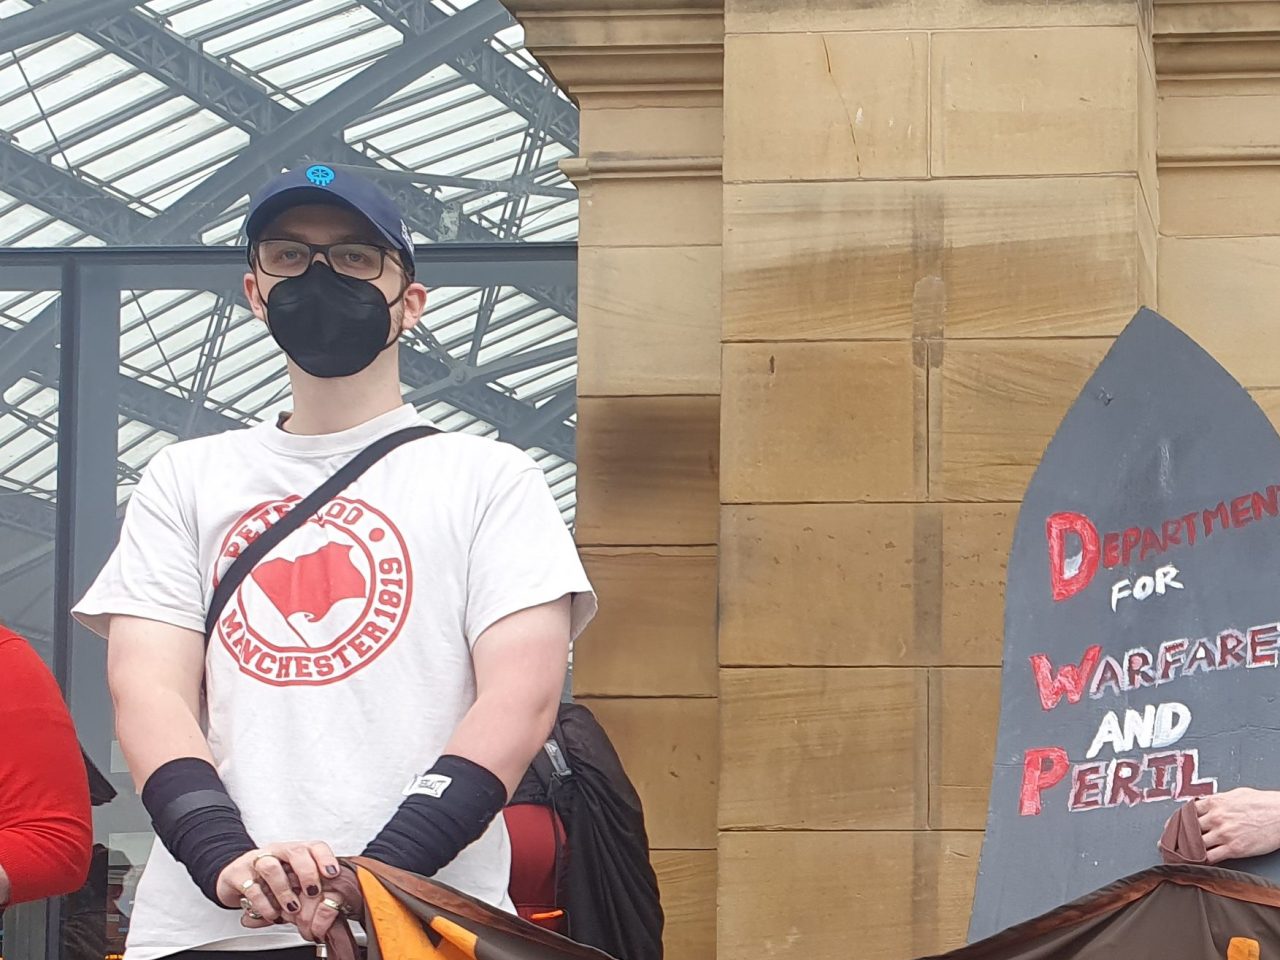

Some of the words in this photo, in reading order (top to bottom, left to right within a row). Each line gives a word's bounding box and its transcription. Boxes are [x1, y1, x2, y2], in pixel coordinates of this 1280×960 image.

[222, 608, 389, 679] MANCHESTER
[374, 557, 404, 623] 1819
[1110, 562, 1185, 613] FOR
[1086, 702, 1192, 759] AND
[1019, 745, 1219, 816] PERIL
